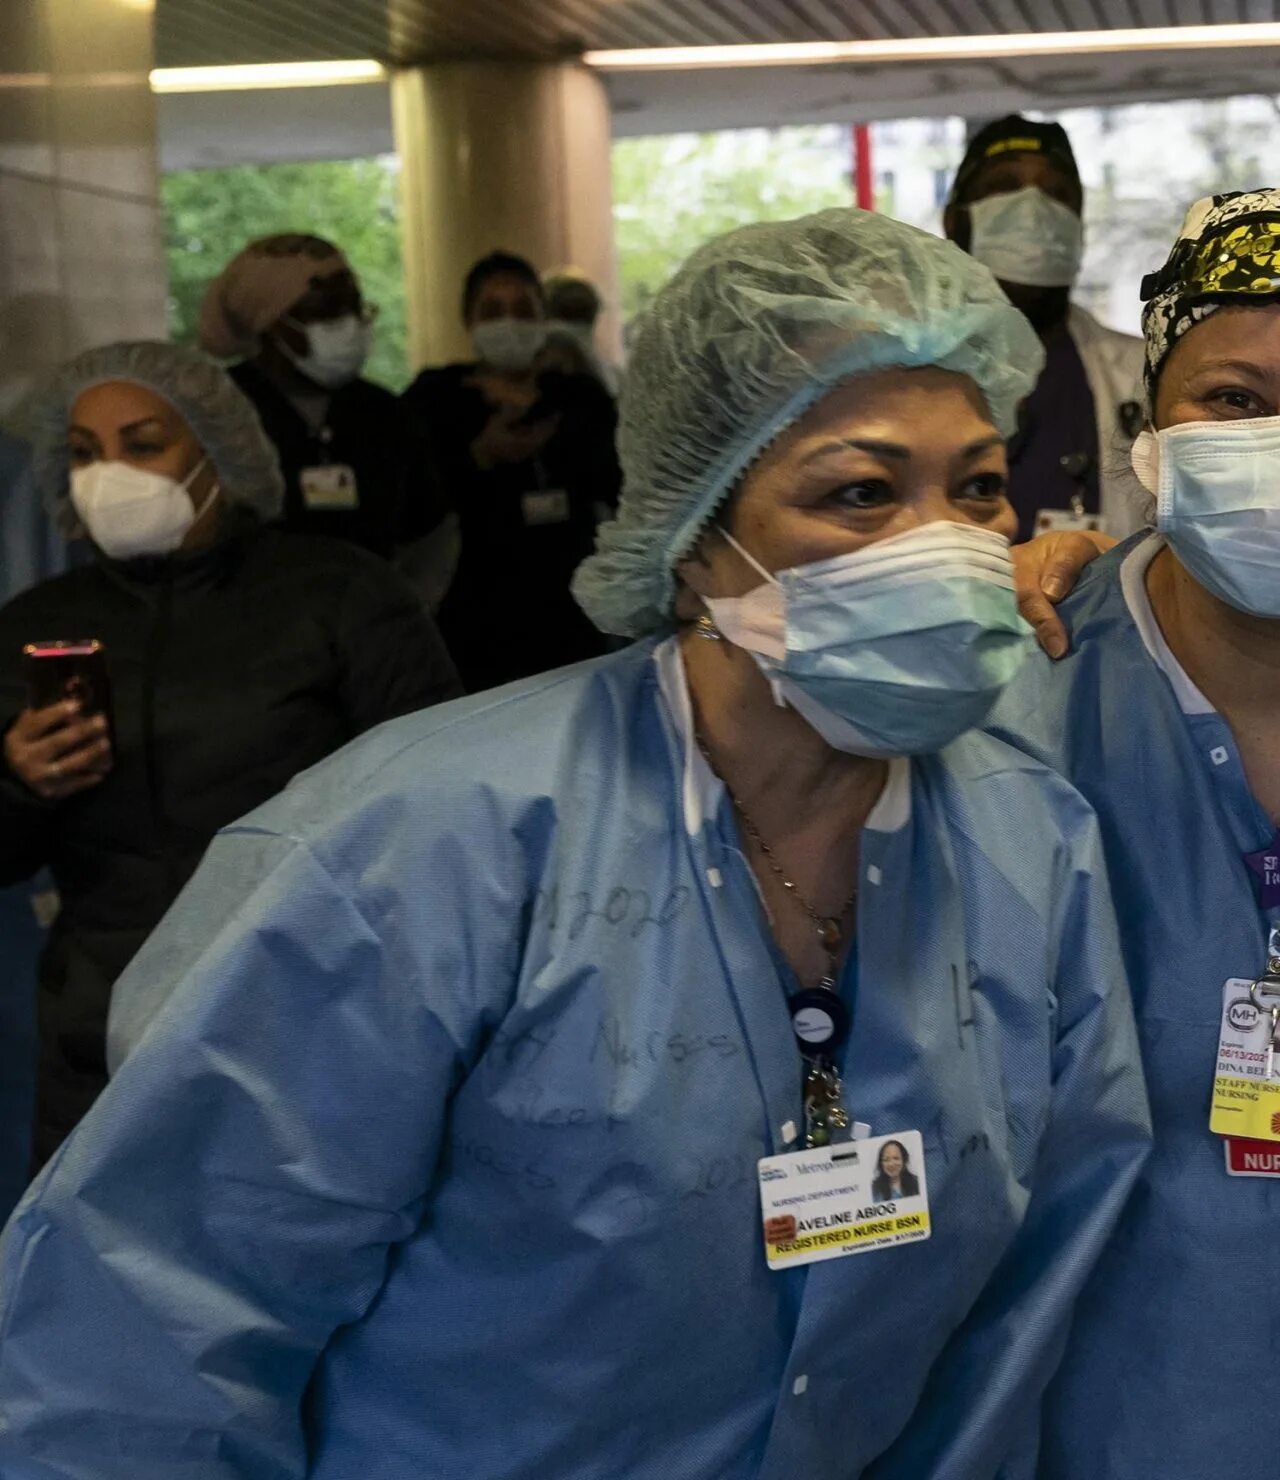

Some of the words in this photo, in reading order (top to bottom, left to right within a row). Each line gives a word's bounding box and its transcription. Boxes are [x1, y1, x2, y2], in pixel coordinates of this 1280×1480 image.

[568, 885, 690, 941] 2020
[1231, 1008, 1257, 1021] MH
[1217, 1062, 1244, 1074] DINA
[1215, 1078, 1246, 1088] STAFF
[1215, 1088, 1259, 1101] NURSING
[772, 1194, 807, 1208] NURSING
[807, 1184, 859, 1201] DEPARTMENT
[797, 1211, 852, 1232] AVELINE
[855, 1203, 897, 1220] ABIOG
[775, 1230, 852, 1253] REGISTERED
[853, 1221, 894, 1238] NURSE
[896, 1215, 920, 1230] BSN
